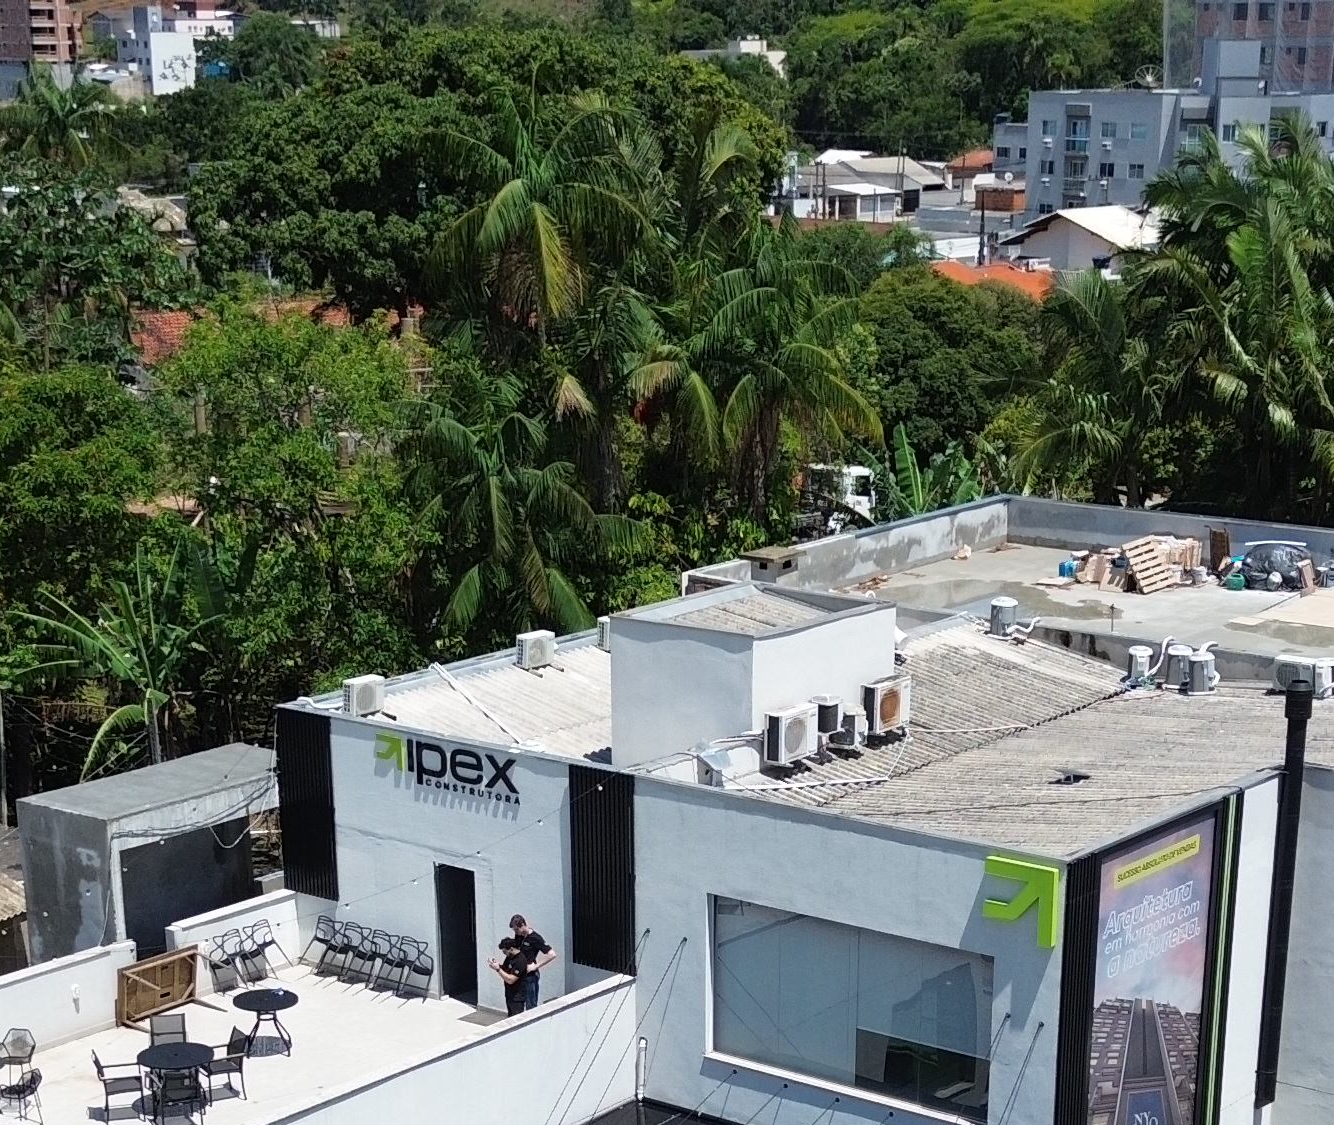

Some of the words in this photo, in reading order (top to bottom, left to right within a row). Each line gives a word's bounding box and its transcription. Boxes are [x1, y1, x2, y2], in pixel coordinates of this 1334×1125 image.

[425, 779, 521, 806] CONSTRUTORA
[1102, 881, 1194, 940] Arquitetura
[1105, 937, 1122, 954] em
[1125, 913, 1175, 946] harmonia
[1178, 900, 1200, 920] com
[1107, 955, 1120, 978] a
